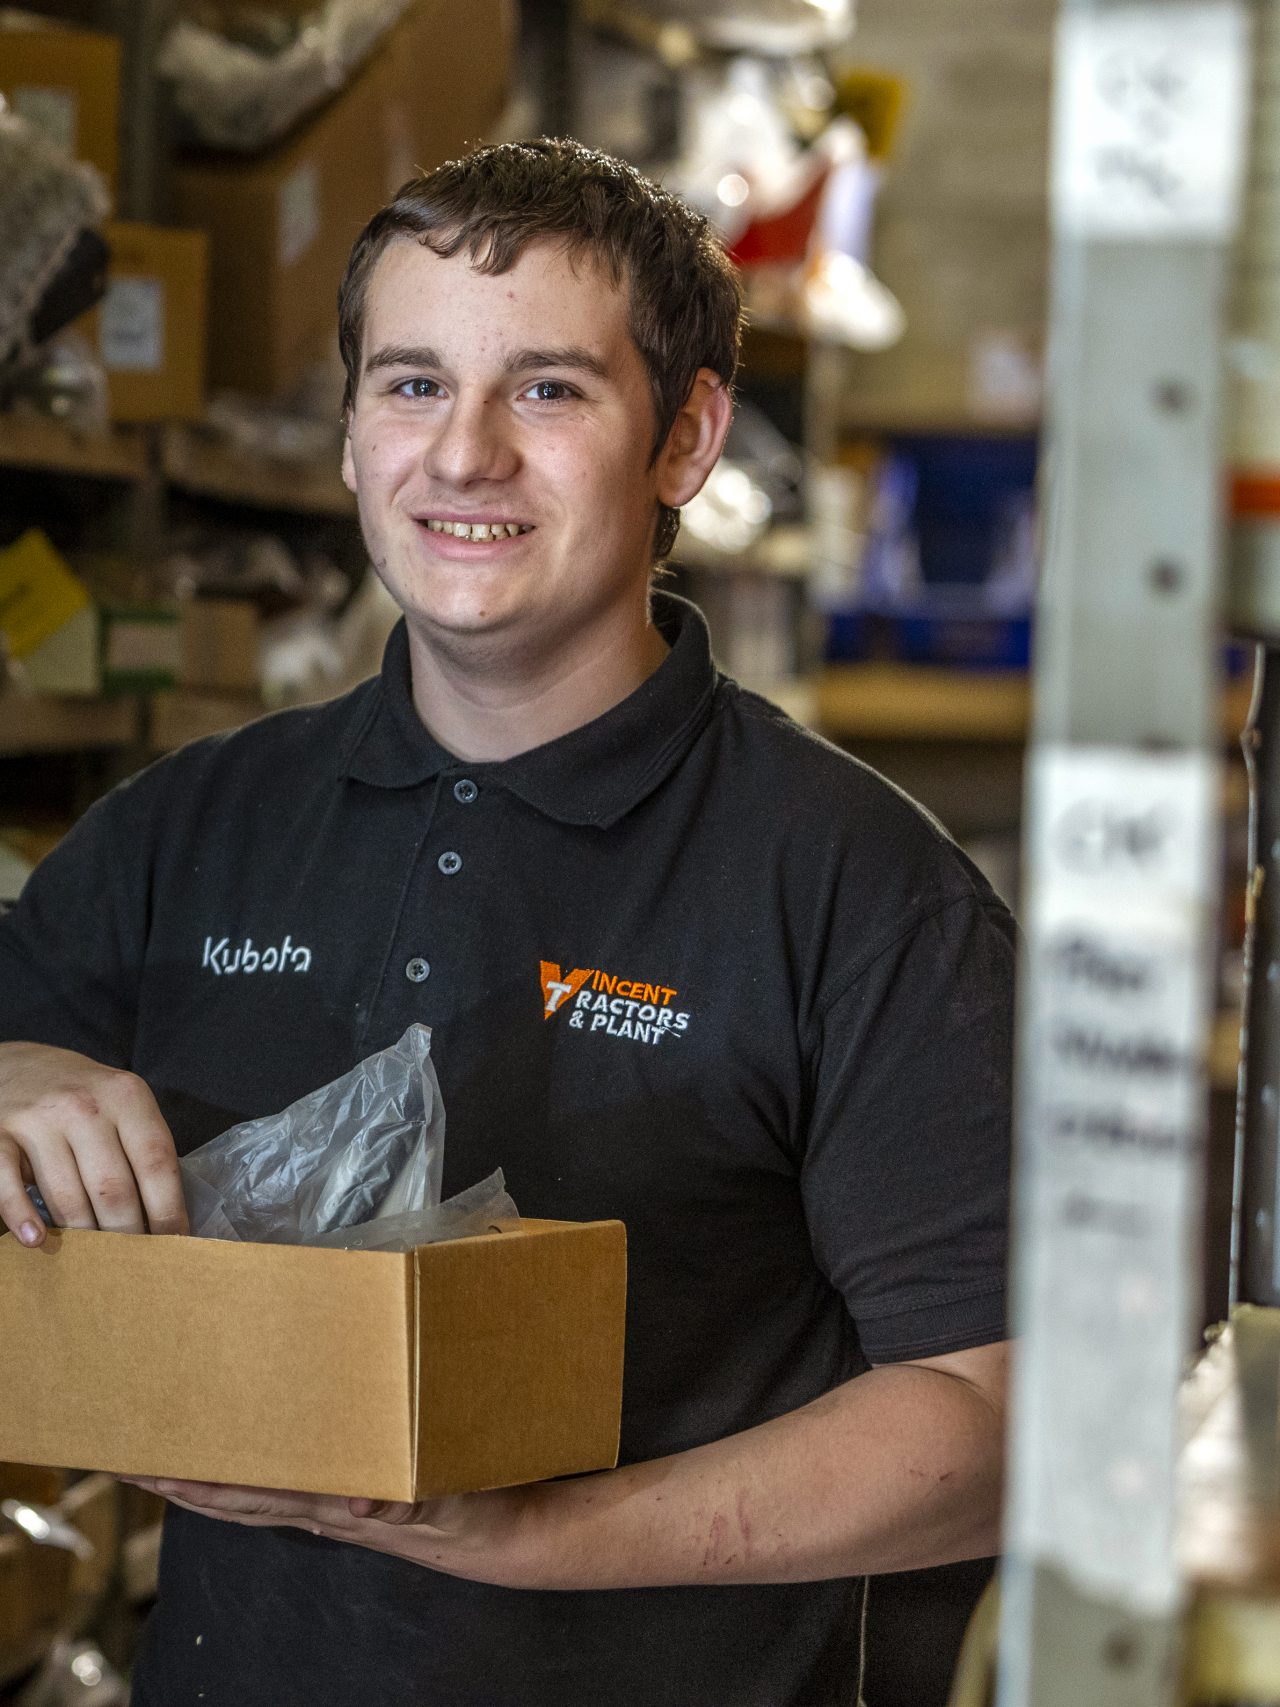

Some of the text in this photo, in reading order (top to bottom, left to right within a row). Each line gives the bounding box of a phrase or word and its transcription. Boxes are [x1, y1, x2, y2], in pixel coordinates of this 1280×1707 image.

[201, 934, 312, 976] Kubota
[540, 959, 678, 1020] VINCENT
[545, 981, 691, 1030] TRACTORS
[568, 1009, 666, 1045] & PLANT
